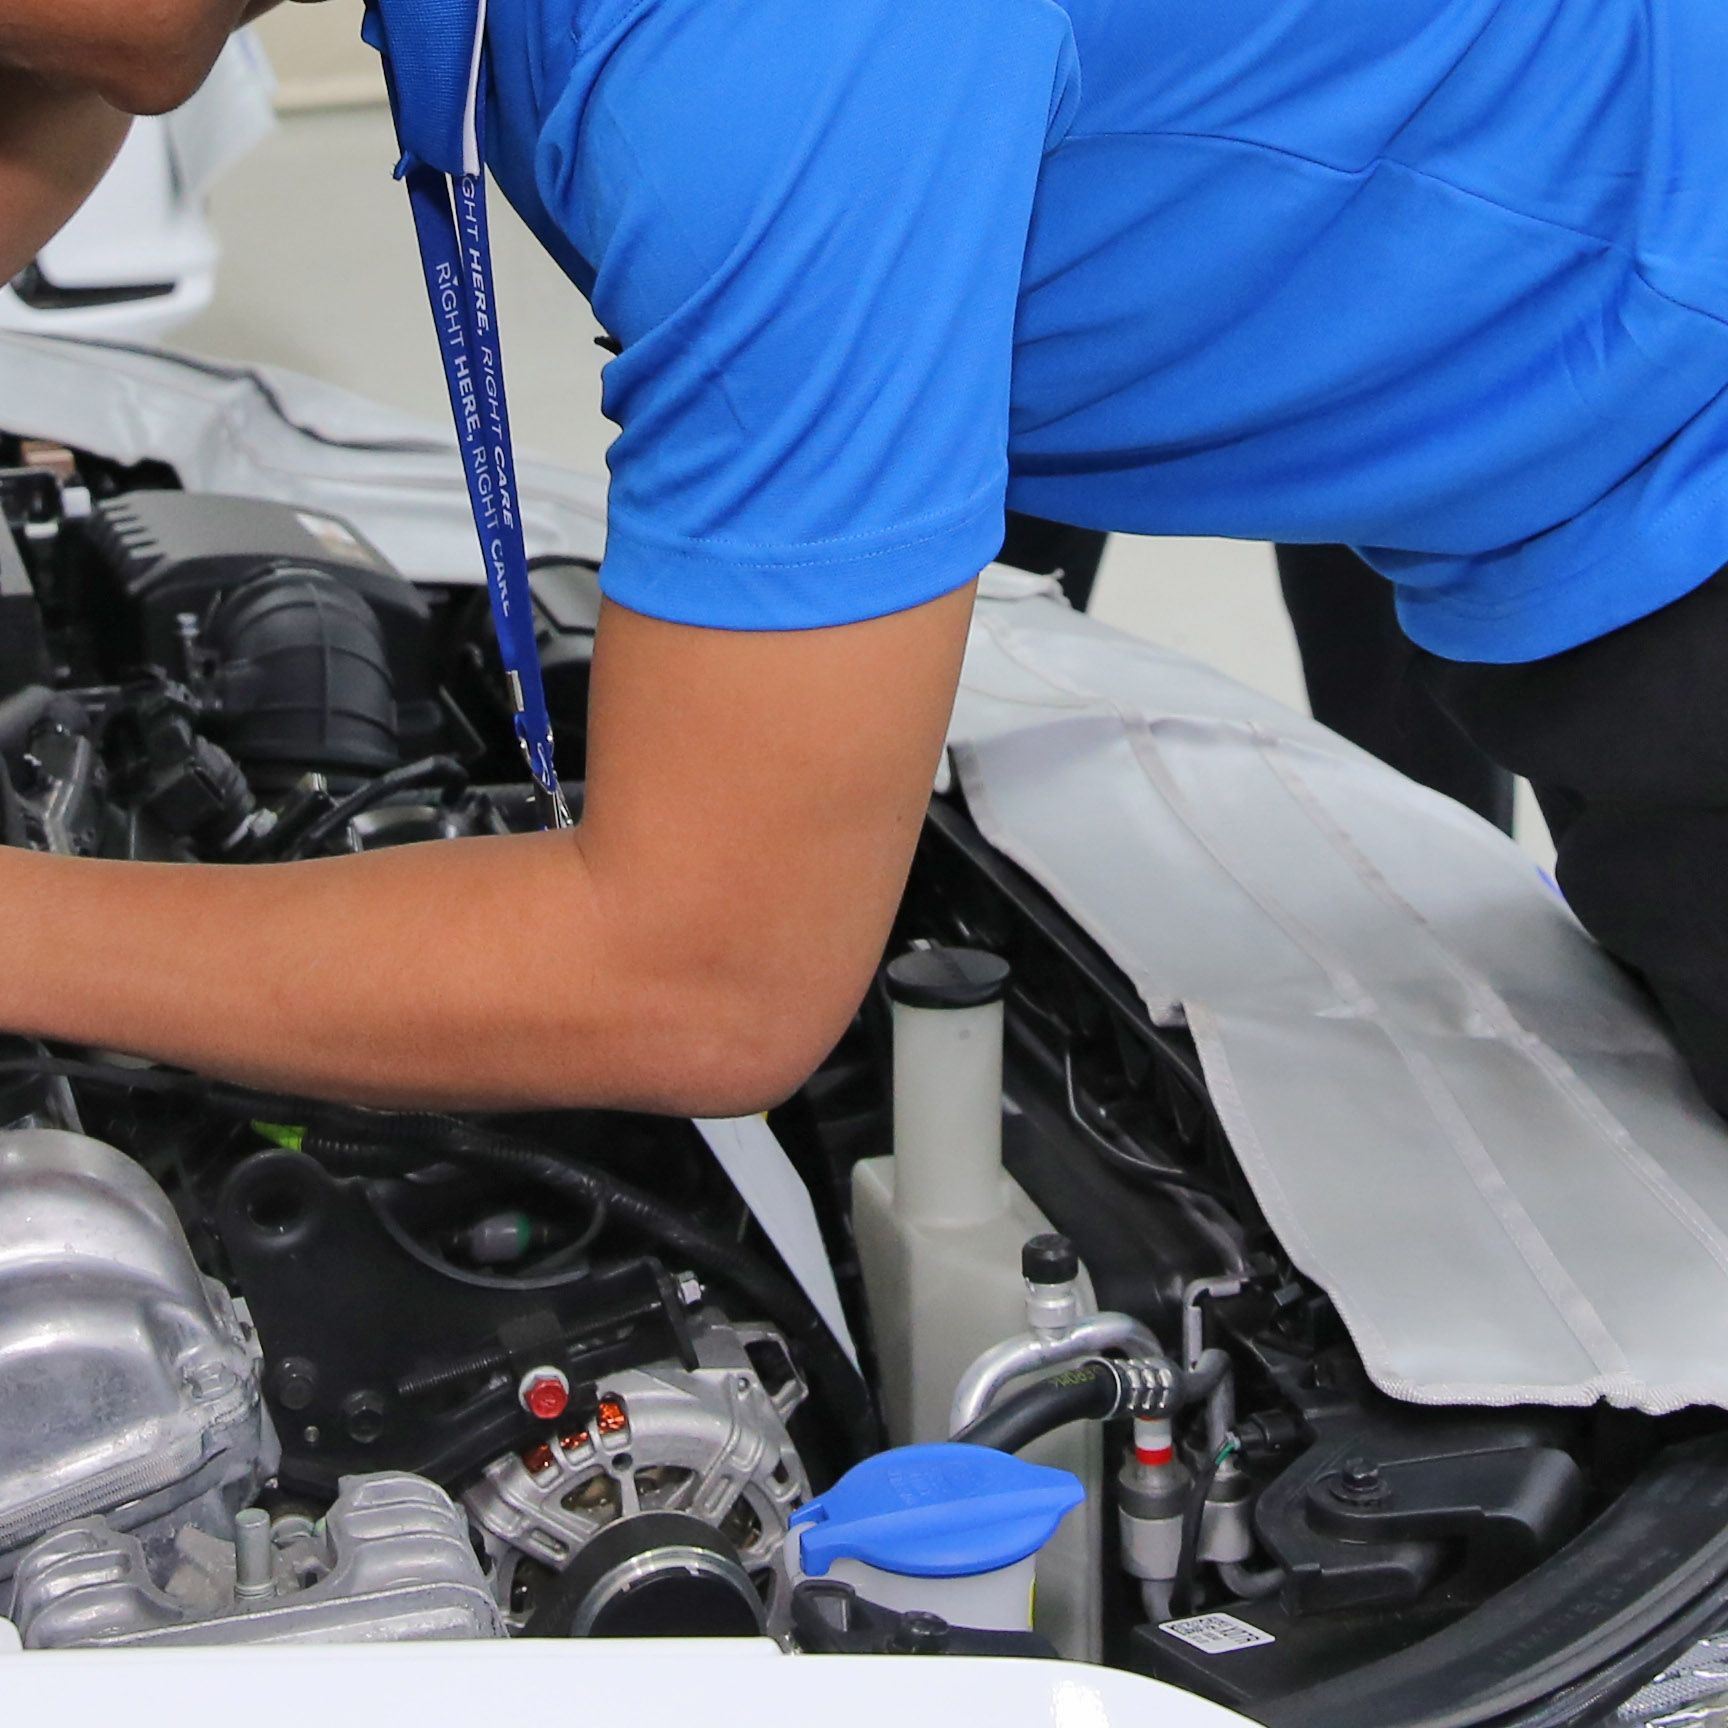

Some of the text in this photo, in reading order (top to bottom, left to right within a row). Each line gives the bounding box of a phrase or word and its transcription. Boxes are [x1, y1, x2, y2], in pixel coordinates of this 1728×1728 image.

[435, 262, 465, 348] RIGHT
[454, 355, 481, 442] HERE,
[472, 446, 500, 529] RIGHT
[461, 173, 514, 530] GHT HERE, RIGHT CARE
